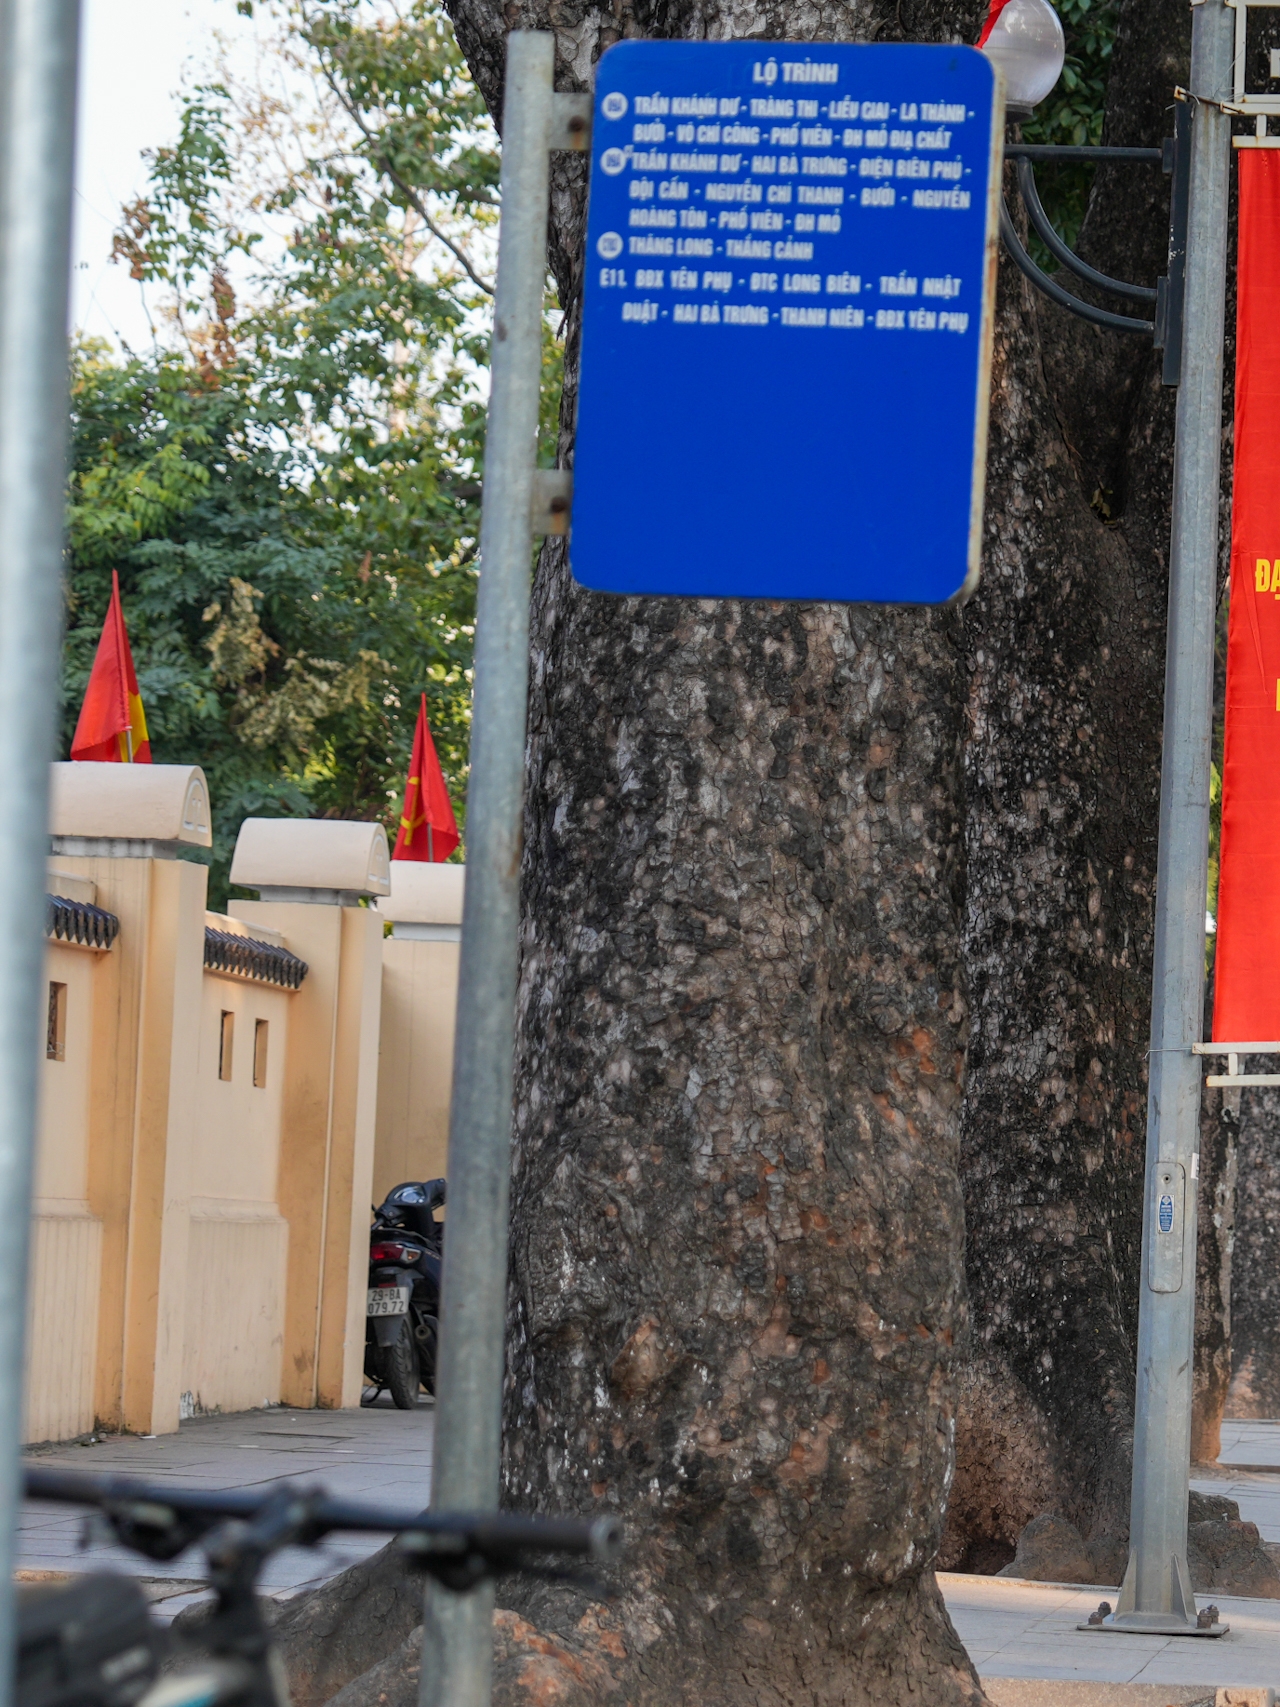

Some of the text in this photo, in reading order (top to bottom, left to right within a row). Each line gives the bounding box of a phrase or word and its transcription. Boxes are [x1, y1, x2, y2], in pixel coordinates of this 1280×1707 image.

[752, 57, 839, 87] LỘ TRÌNH
[861, 101, 890, 120] GIAI
[900, 103, 918, 121] LA
[722, 121, 760, 145] CÔNG
[770, 121, 799, 146] PHỐ
[915, 125, 952, 149] CHẤT
[751, 155, 776, 174] HAI
[858, 156, 894, 180] ĐIỆN
[895, 156, 930, 178] BIÊN
[705, 178, 763, 202] NGUYỄN
[767, 182, 793, 204] CHÍ
[797, 186, 844, 205] THANH
[912, 184, 971, 209] NGUYỄN
[629, 205, 677, 228] HOÀNG
[679, 206, 708, 229] TÔN
[718, 204, 749, 230] PHỐ
[750, 209, 784, 231] VIÊN
[817, 208, 842, 234] MỎ
[676, 237, 714, 256] LONG
[774, 235, 814, 260] CẢNH
[670, 266, 698, 290] YÊN
[702, 271, 733, 294] PHỤ
[783, 273, 821, 293] LONG
[826, 271, 861, 294] BIÊN
[922, 274, 962, 299] NHẬT
[673, 303, 699, 324] HAI
[700, 299, 721, 324] BÀ
[723, 304, 769, 326] TRƯNG
[781, 307, 827, 327] THANH
[829, 305, 864, 328] NIÊN
[908, 307, 936, 330] YÊN
[938, 311, 969, 334] PHỤ
[368, 1301, 404, 1314] 079.72
[372, 1289, 401, 1301] 29-BA
